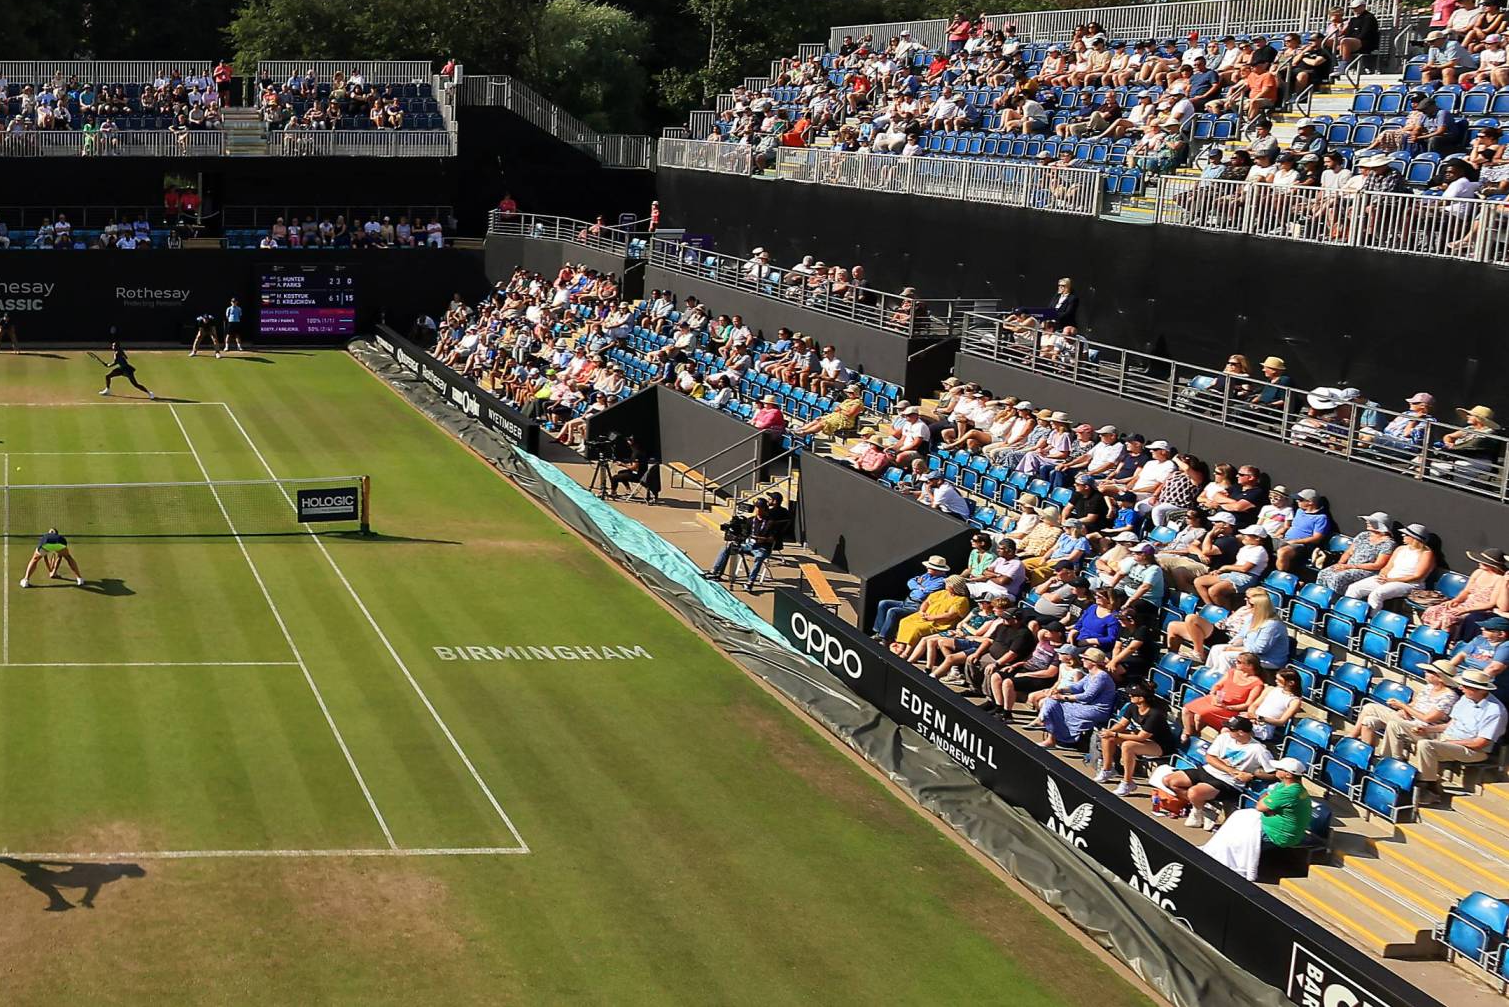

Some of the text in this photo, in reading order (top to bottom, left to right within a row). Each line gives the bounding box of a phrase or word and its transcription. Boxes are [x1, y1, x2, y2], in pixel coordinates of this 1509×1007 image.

[115, 287, 191, 302] Rothesay
[488, 408, 523, 440] NYETIMBER
[301, 495, 354, 508] HOLOGIC
[433, 645, 654, 661] BIRMINGHAM
[791, 612, 863, 679] oppo
[900, 686, 998, 770] EDEN.MILL
[929, 734, 977, 770] ANDREWS
